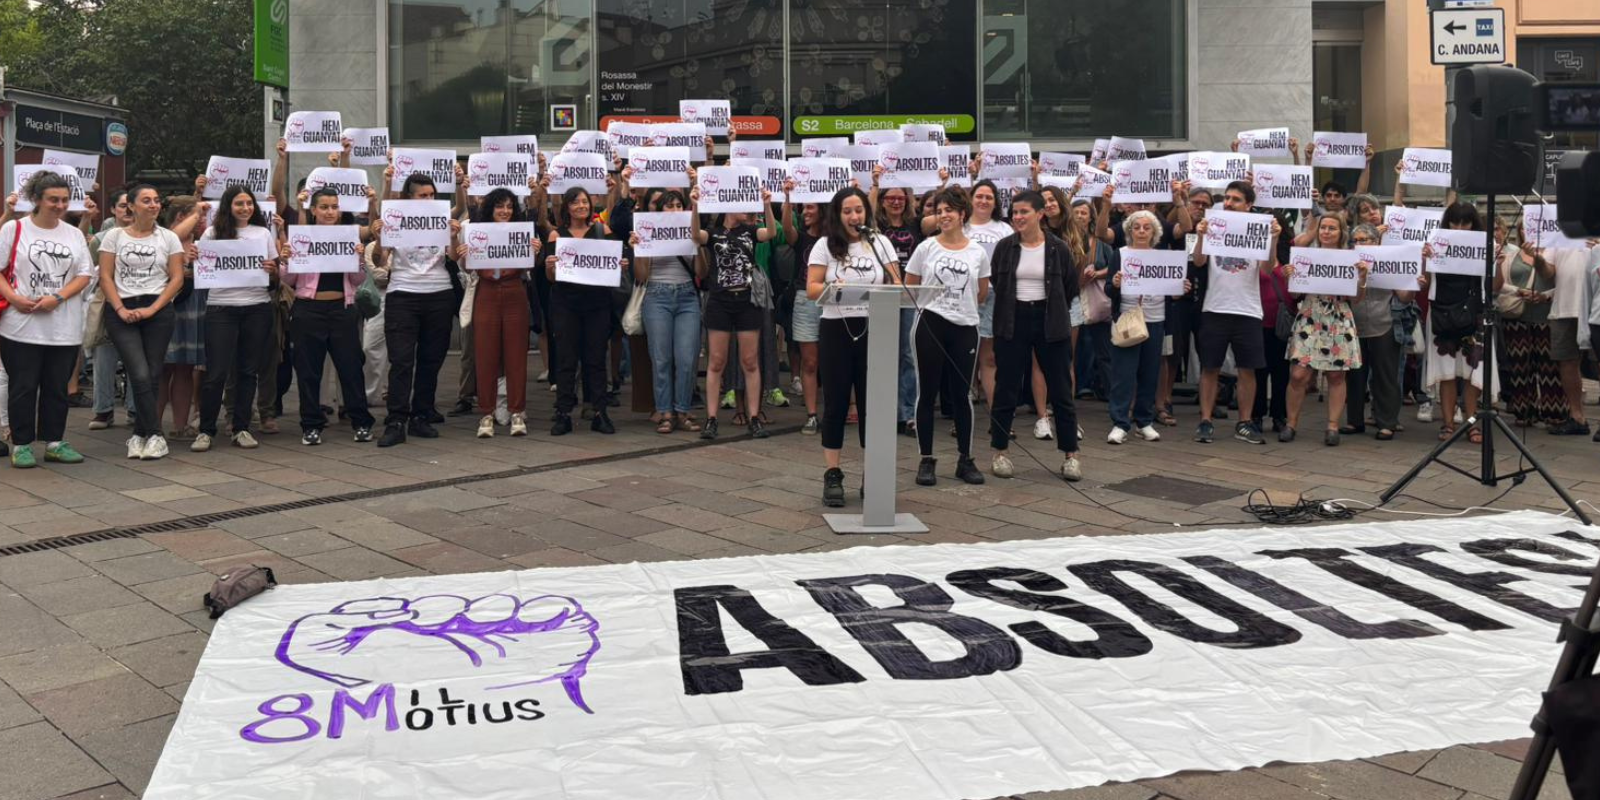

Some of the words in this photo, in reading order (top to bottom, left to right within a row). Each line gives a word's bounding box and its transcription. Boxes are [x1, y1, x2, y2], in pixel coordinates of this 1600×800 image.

[1437, 44, 1449, 55] C.
[1452, 43, 1500, 55] ANDANA
[601, 71, 637, 79] Rosassa
[601, 82, 614, 90] del
[616, 82, 652, 90] Monestir
[611, 93, 625, 101] XIV
[711, 107, 728, 117] HEM
[25, 117, 43, 132] Plaça
[44, 121, 53, 131] de
[53, 122, 80, 136] l'Estació
[322, 120, 340, 131] HEM
[801, 119, 819, 131] S2
[835, 119, 894, 129] Barcelona
[303, 131, 341, 143] GUANYAT
[370, 135, 387, 146] HEM
[666, 135, 704, 147] ABSOLTES
[1269, 131, 1286, 140] HEM
[1254, 139, 1286, 149] GUANYAT
[1327, 144, 1364, 156] ABSOLTES
[354, 146, 387, 157] GUANYAT
[765, 148, 782, 160] HEM
[433, 158, 453, 170] HEM
[645, 160, 686, 172] ABSOLTES
[896, 157, 938, 171] ABSOLTES
[948, 154, 967, 167] HEM
[994, 154, 1029, 165] ABSOLTES
[1226, 159, 1246, 169] HEM
[248, 168, 268, 180] HEM
[507, 161, 527, 174] HEM
[563, 166, 605, 179] ABSOLTES
[829, 167, 850, 179] HEM
[488, 173, 527, 186] GUANYAT
[768, 168, 786, 181] HEM
[1150, 168, 1169, 181] HEM
[1207, 168, 1246, 181] GUANYAT
[1291, 173, 1310, 185] HEM
[738, 175, 759, 189] HEM
[1130, 180, 1169, 193] GUANYAT
[718, 189, 759, 202] GUANYAT
[1272, 185, 1310, 199] GUANYAT
[400, 216, 447, 230] ABSOLTES
[1246, 222, 1269, 237] HEM
[508, 231, 530, 245] HEM
[651, 226, 692, 241] ABSOLTES
[1402, 228, 1429, 242] GUAN
[1224, 233, 1268, 250] GUANYAT
[308, 241, 355, 256] ABSOLTES
[488, 244, 530, 259] GUANYAT
[1445, 244, 1487, 260] ABSOLTE
[215, 255, 264, 270] ABSOLTES
[573, 254, 618, 270] ABSOLTES
[1372, 261, 1418, 275] ABSOLTES
[1138, 265, 1183, 279] ABSOLTES
[1308, 264, 1355, 279] ABSOLTES
